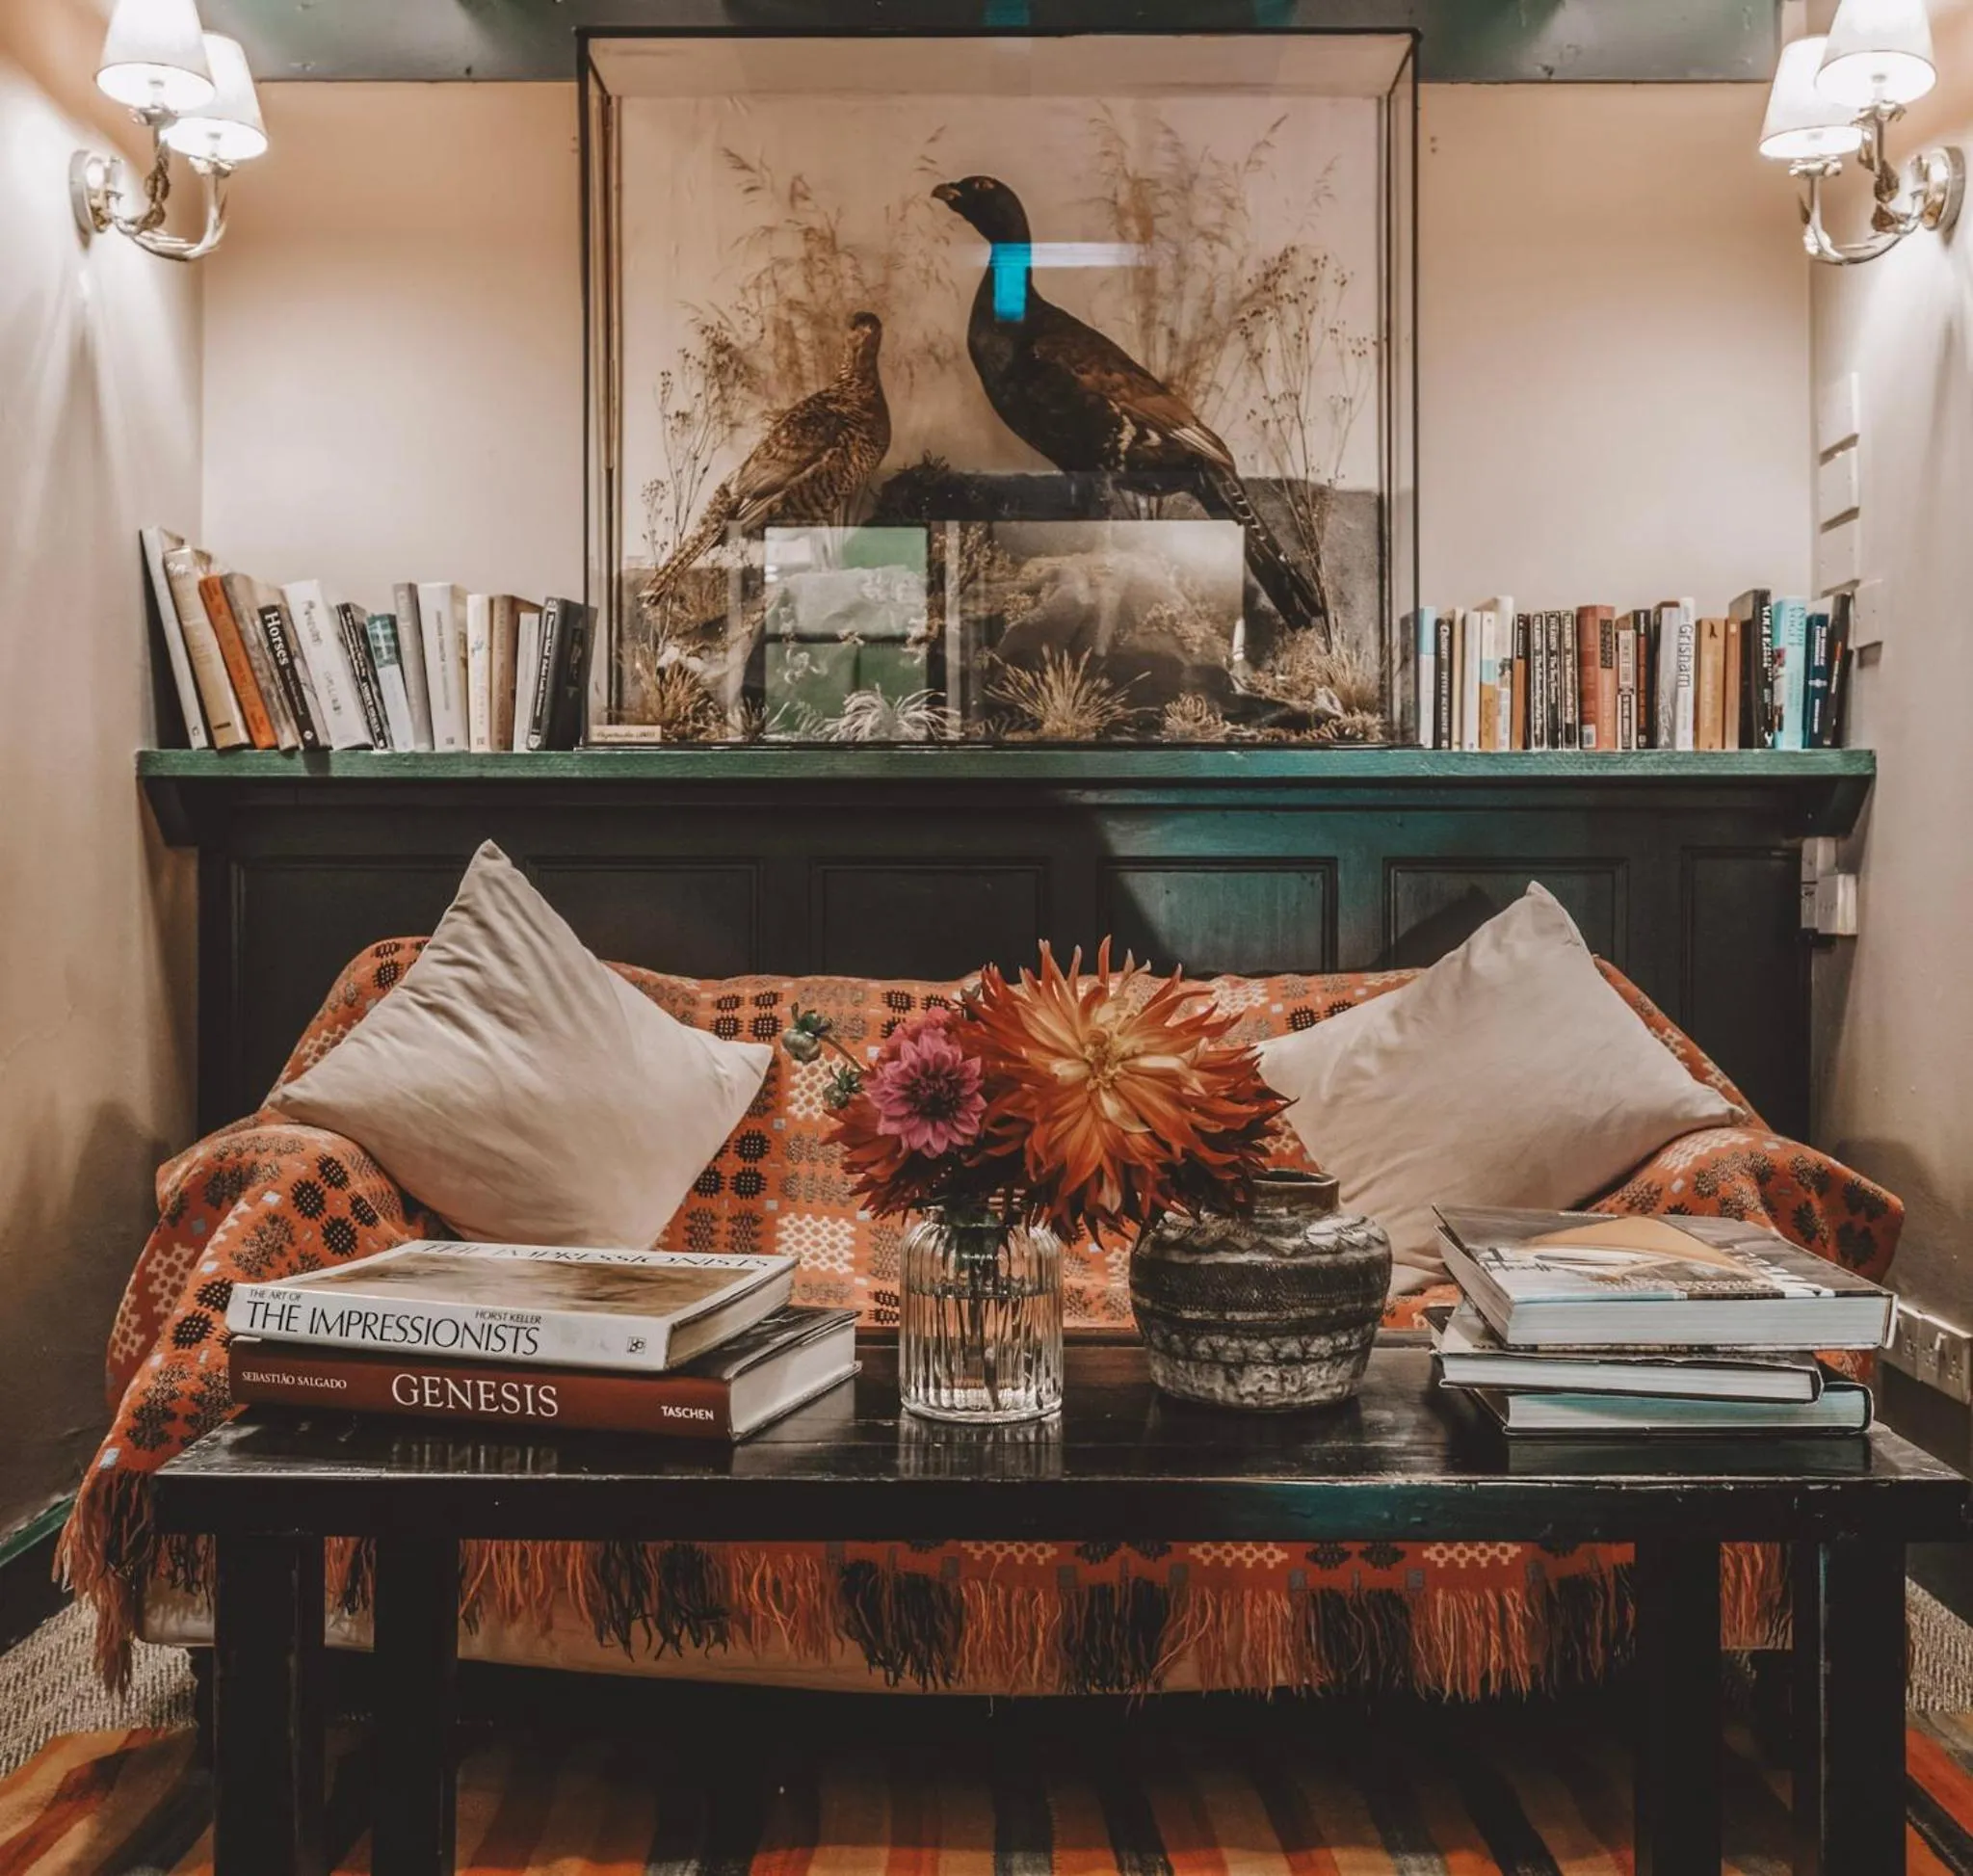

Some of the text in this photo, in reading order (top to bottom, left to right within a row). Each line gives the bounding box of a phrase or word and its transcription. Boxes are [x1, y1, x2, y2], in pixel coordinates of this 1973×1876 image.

[264, 610, 290, 667] Horses
[1677, 624, 1694, 688] Grisham
[250, 1289, 302, 1302] THE ART OF
[247, 1300, 539, 1356] THE IMPRESSIONISTS
[475, 1310, 541, 1325] HORST KELLER
[297, 1376, 347, 1389] SALGADO
[391, 1373, 559, 1417] GENESIS
[660, 1405, 714, 1421] TASCHEN
